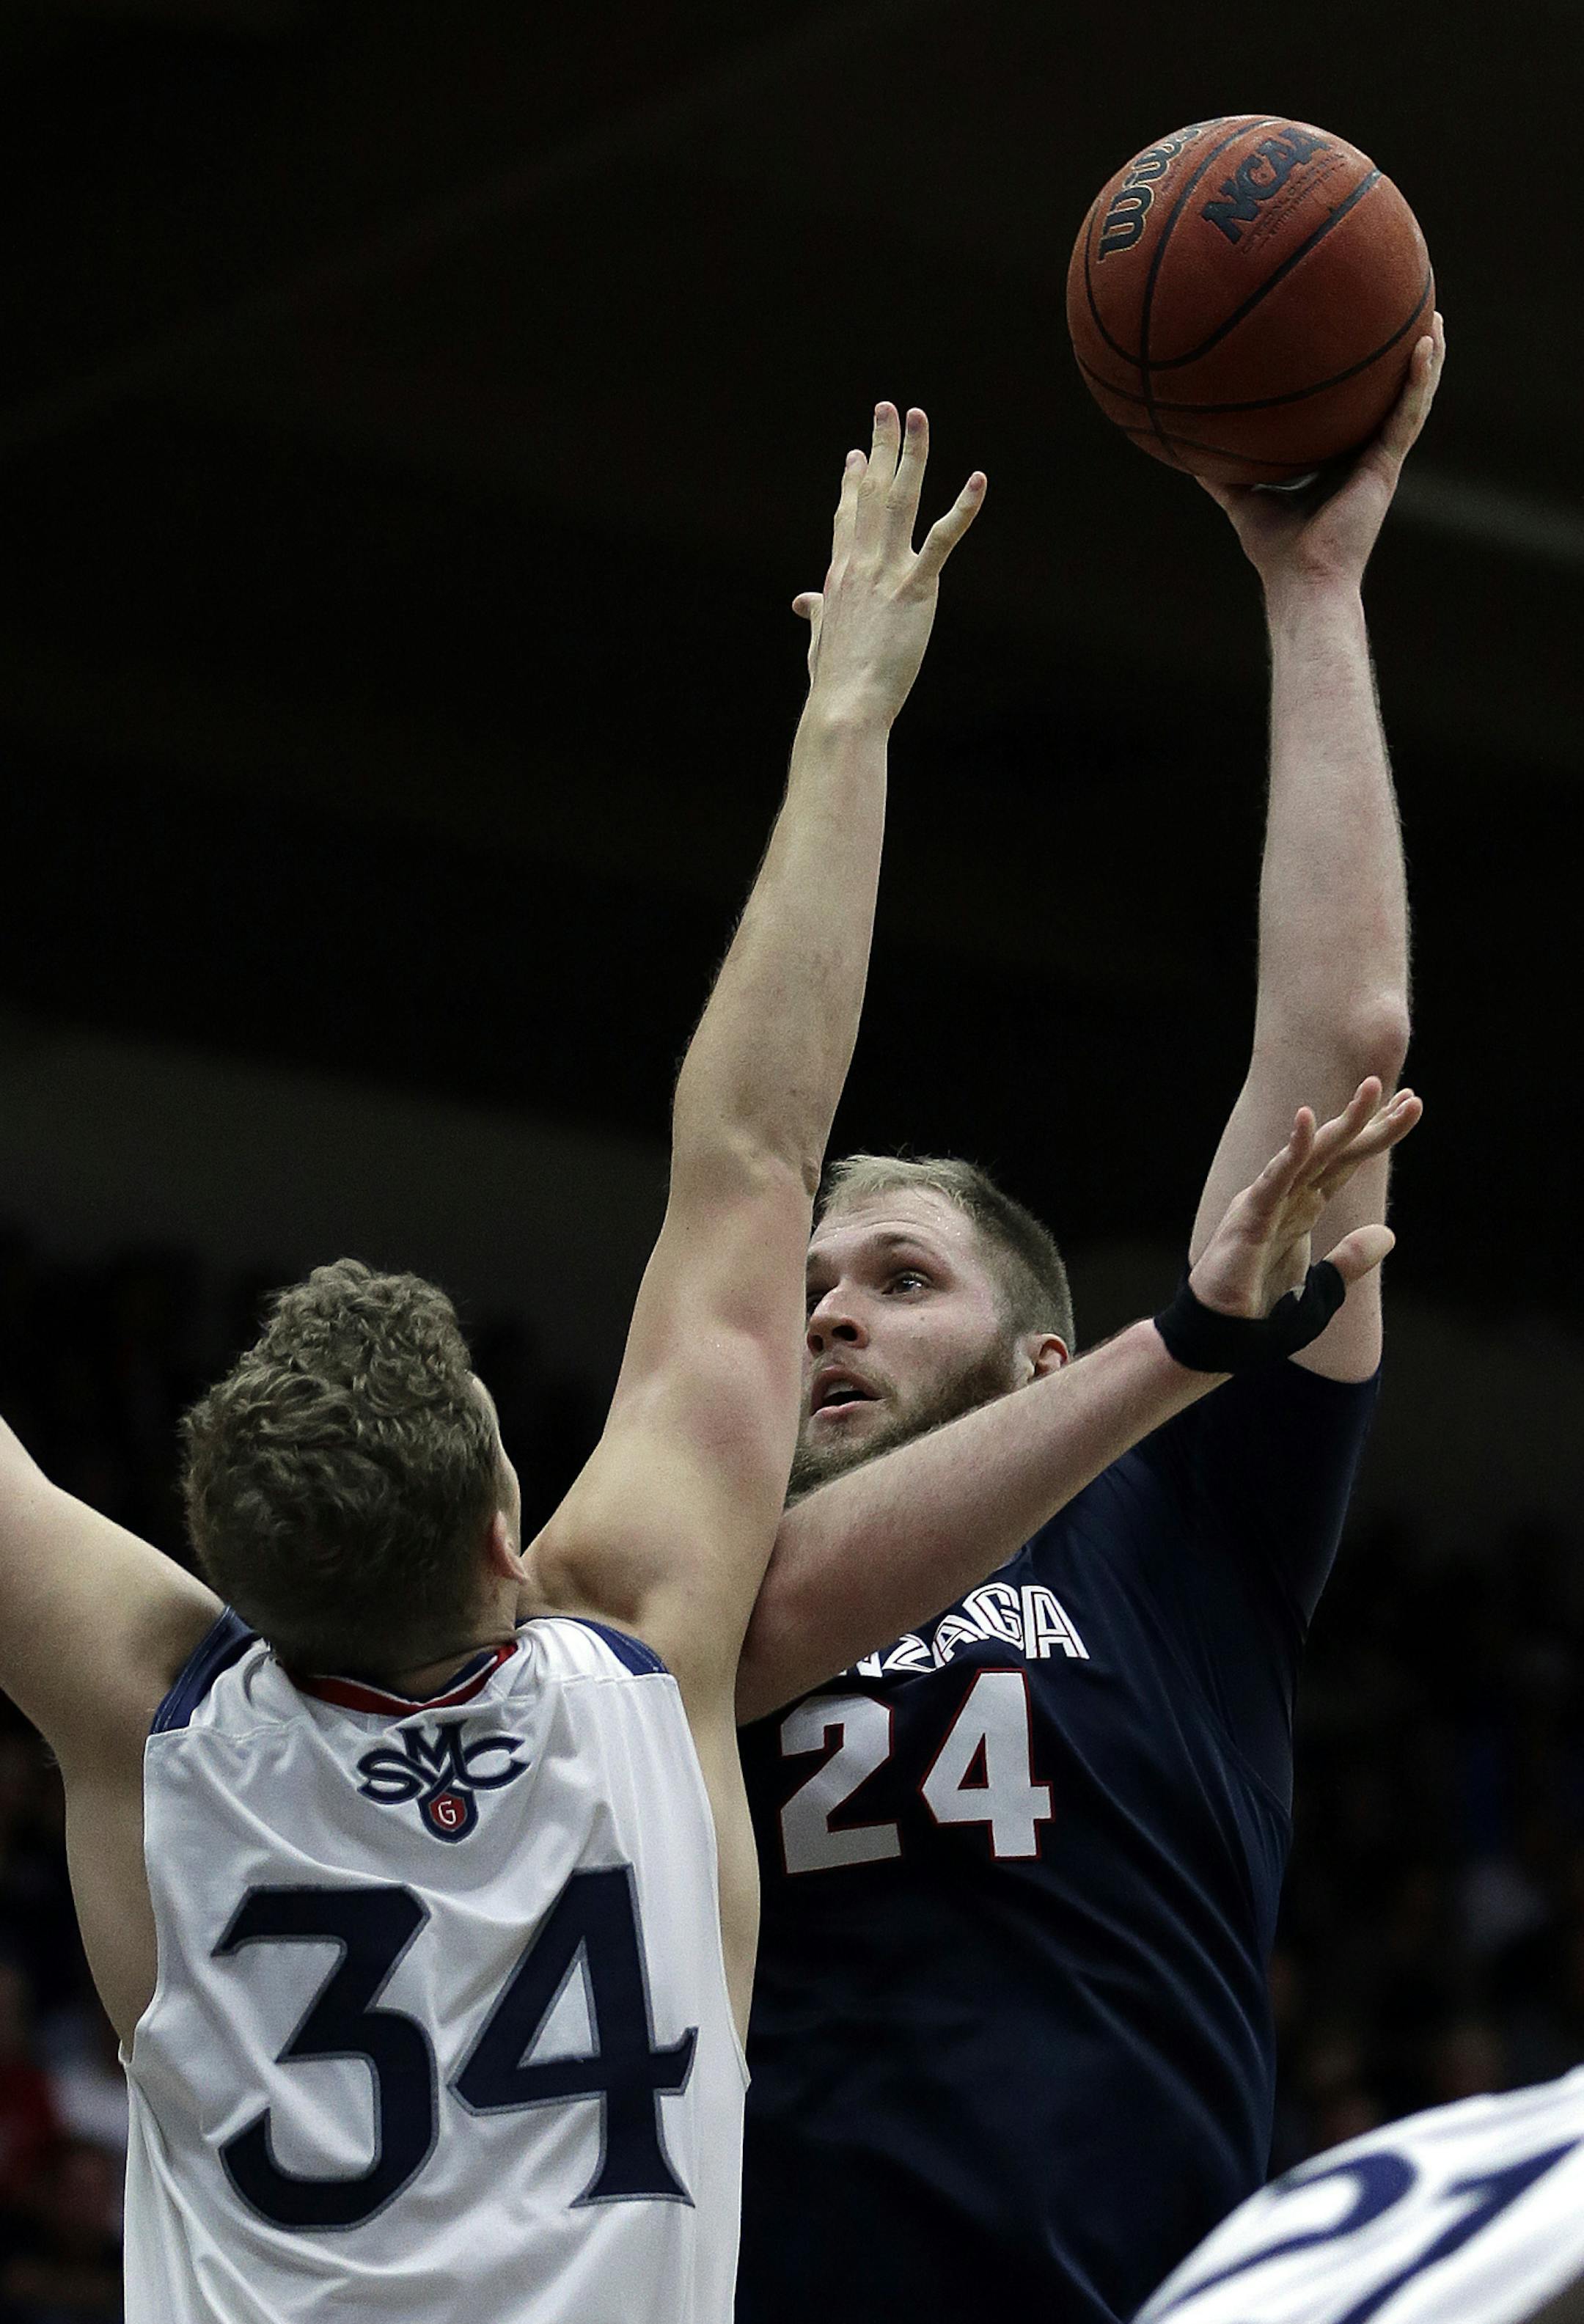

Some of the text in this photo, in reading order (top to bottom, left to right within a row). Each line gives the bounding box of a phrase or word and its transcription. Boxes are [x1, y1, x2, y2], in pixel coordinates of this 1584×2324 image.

[1096, 127, 1202, 265] Wils
[1201, 127, 1332, 245] NCAA
[438, 1800, 457, 1825] G
[780, 1667, 1056, 1877] 24
[210, 1863, 700, 2233] 34
